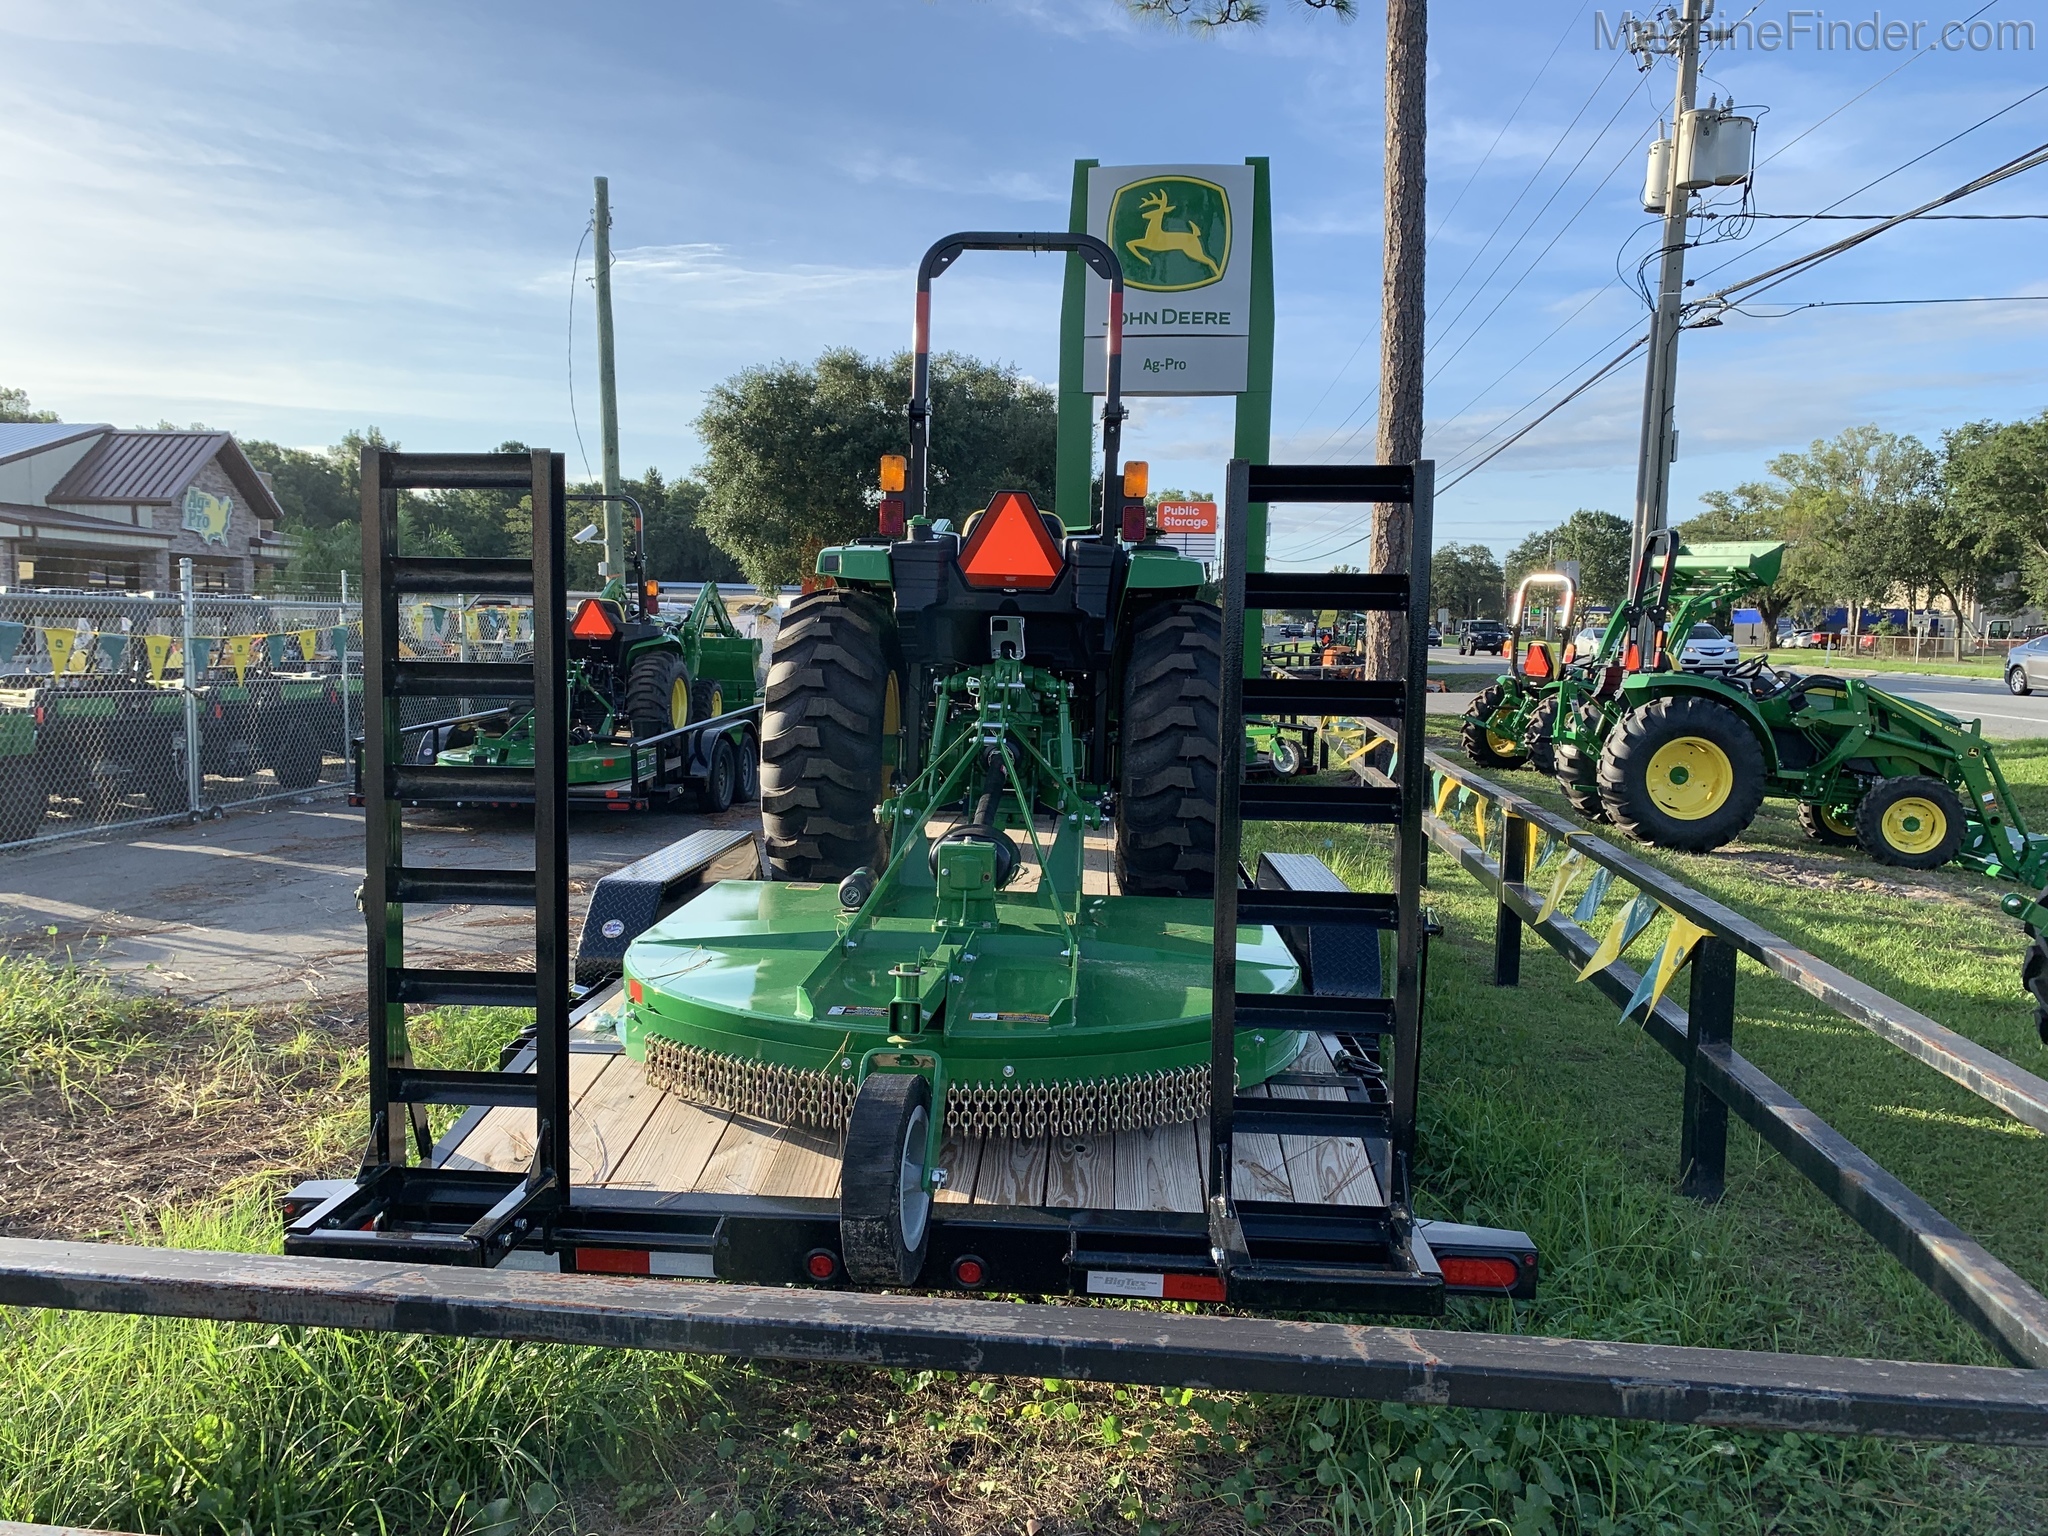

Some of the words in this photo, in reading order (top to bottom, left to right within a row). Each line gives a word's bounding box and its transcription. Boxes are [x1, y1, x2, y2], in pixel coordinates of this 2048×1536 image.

[1162, 308, 1231, 325] DEERE
[1143, 357, 1187, 373] Ag-Pro
[1163, 505, 1200, 516] Public
[187, 509, 210, 529] Pro
[1163, 516, 1209, 529] Storage
[1104, 1276, 1146, 1288] BigTex
